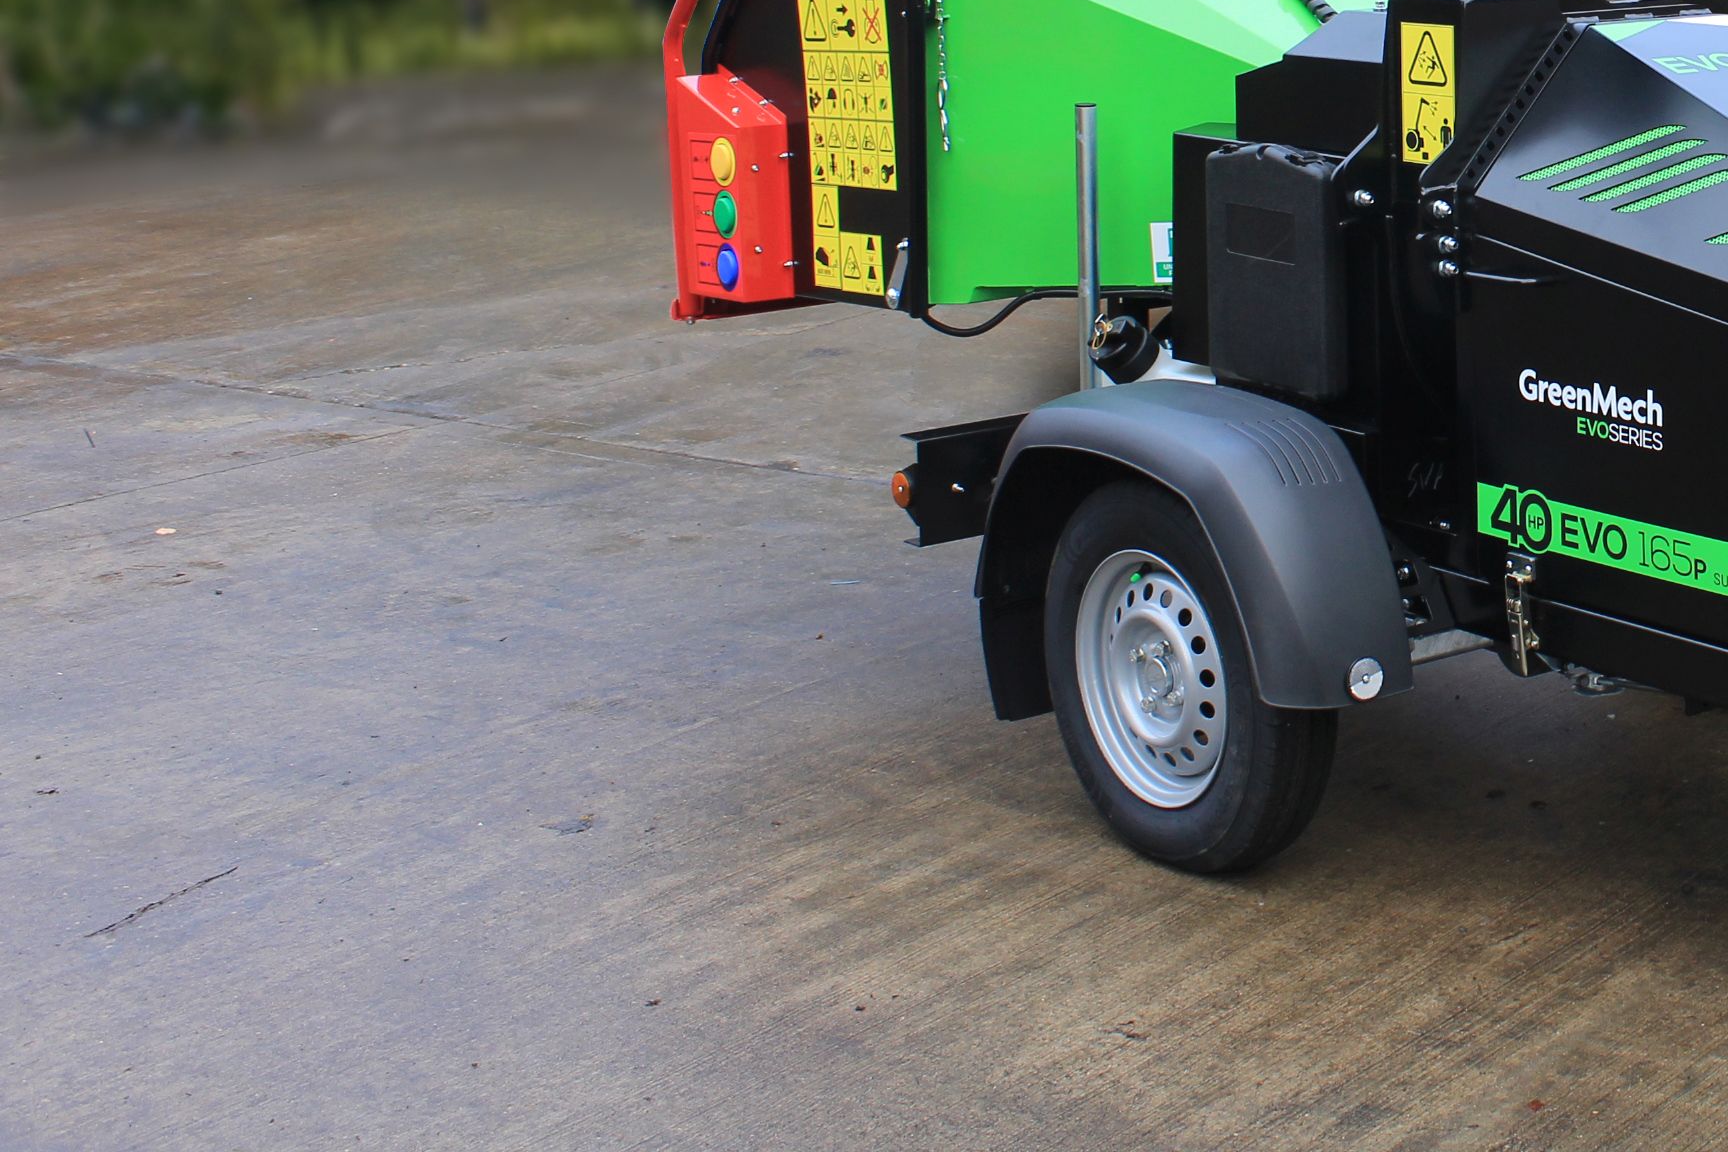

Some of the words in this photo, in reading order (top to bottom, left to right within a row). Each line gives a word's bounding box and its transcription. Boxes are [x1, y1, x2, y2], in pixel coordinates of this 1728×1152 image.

[1518, 368, 1664, 428] GreenMech
[1490, 486, 1553, 552] 40
[1560, 512, 1628, 561] EVO
[1527, 513, 1545, 531] HP
